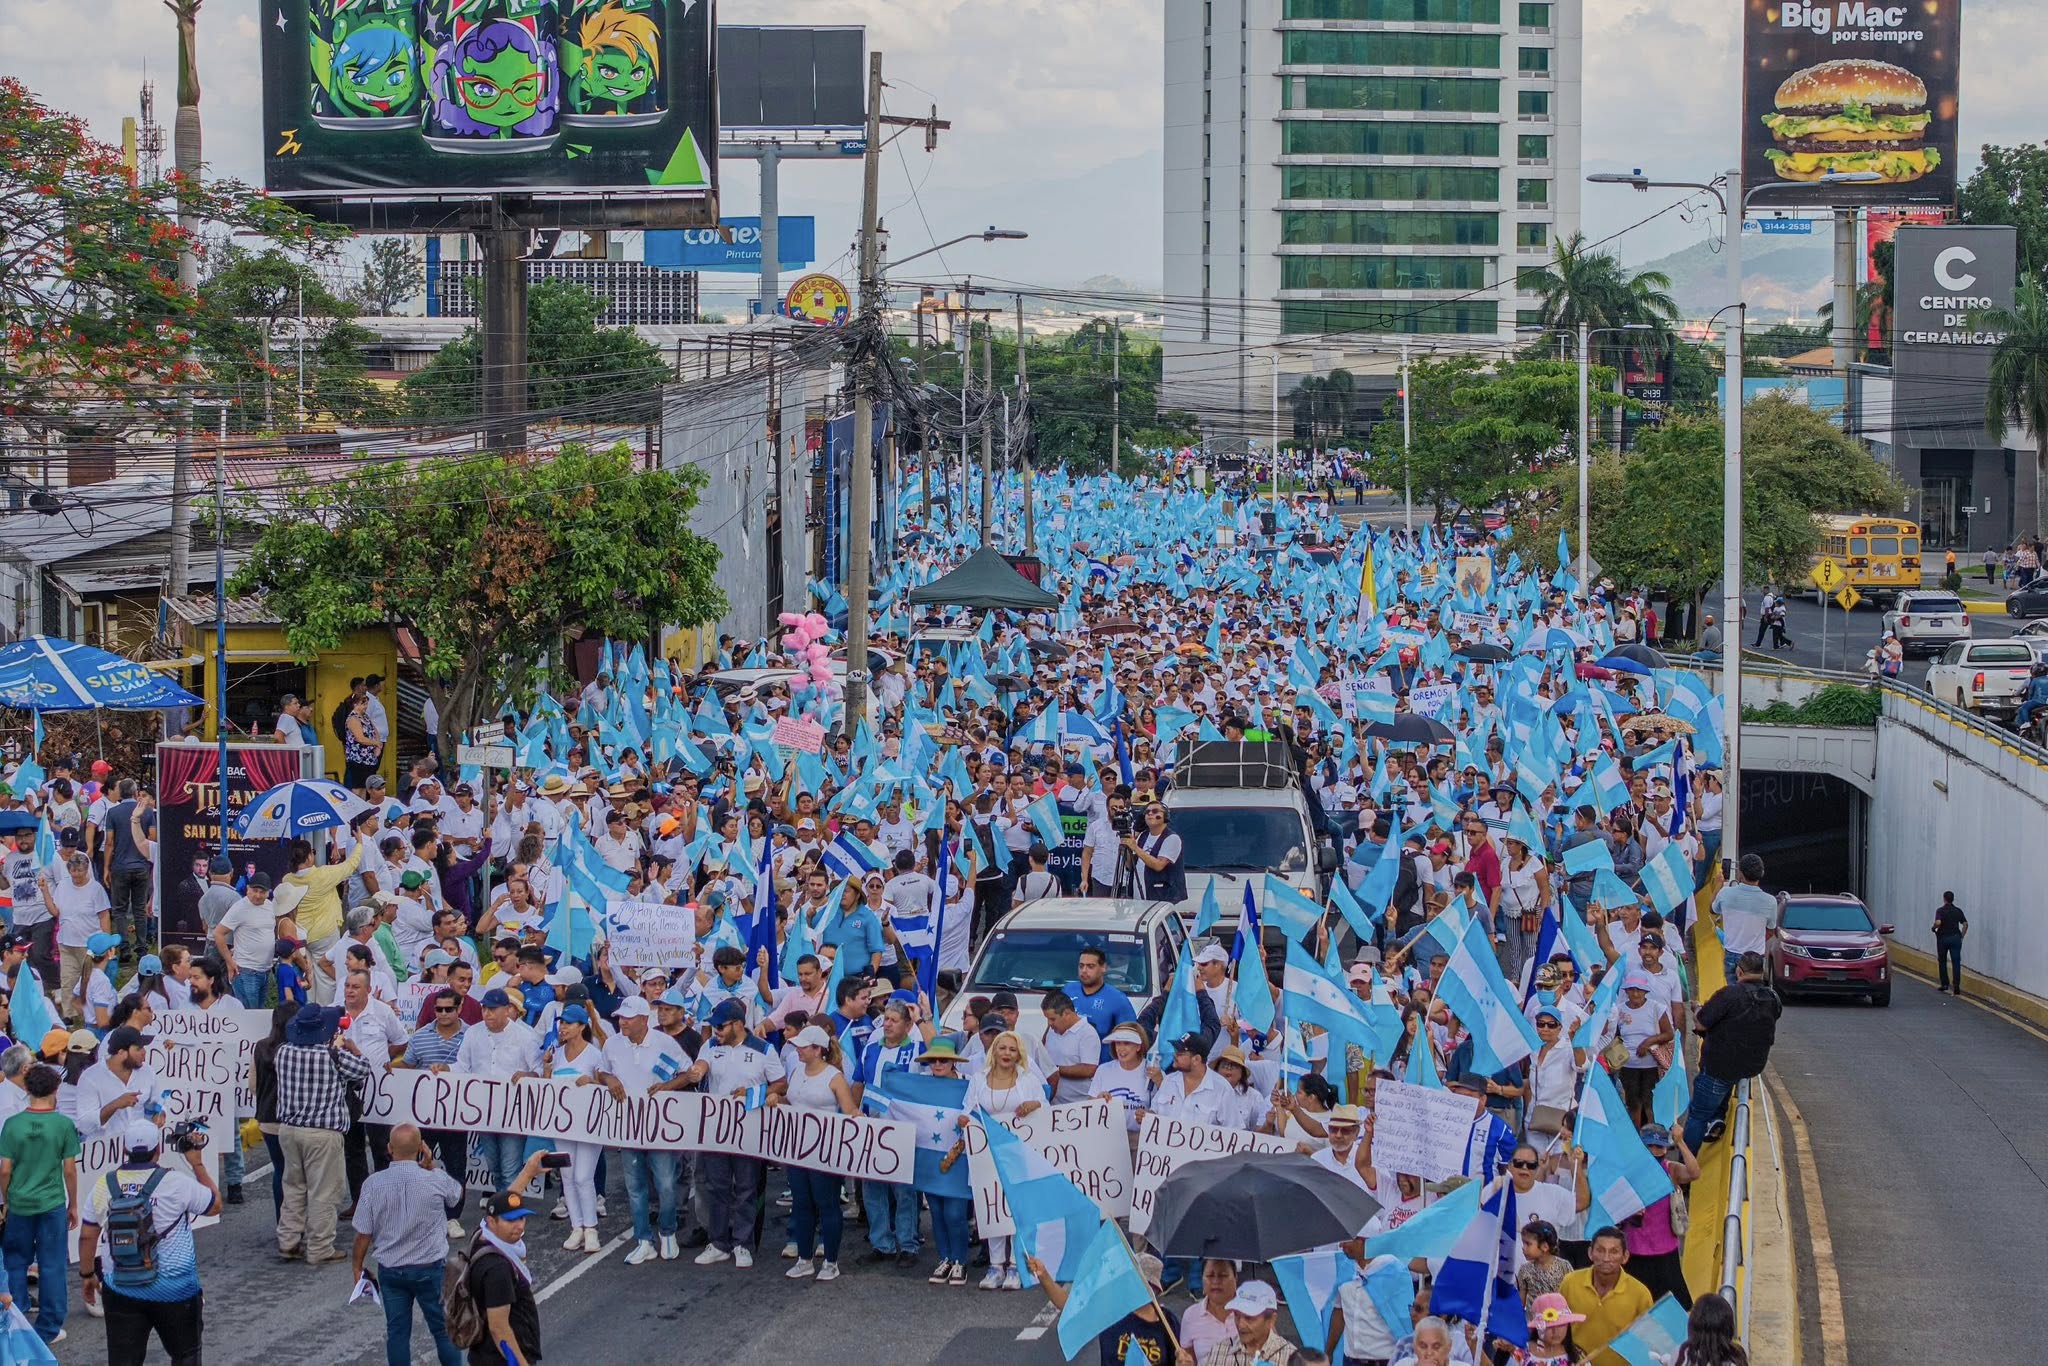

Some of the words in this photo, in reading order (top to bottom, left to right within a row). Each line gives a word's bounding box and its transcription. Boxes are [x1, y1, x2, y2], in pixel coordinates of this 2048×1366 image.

[1781, 0, 1831, 34] Big
[1832, 30, 1859, 44] por
[1861, 28, 1924, 44] siempre
[726, 249, 761, 259] Pintura
[1919, 296, 1993, 310] CENTRO
[1943, 314, 1968, 327] DE
[1903, 331, 2008, 345] CERAMICAS
[1413, 688, 1448, 701] OREMOS
[227, 767, 246, 776] BAC
[184, 825, 207, 839] SAN
[361, 1072, 395, 1118] OS
[411, 1074, 574, 1134] CRISTIANOS
[586, 1087, 685, 1146] ORAMOS
[698, 1095, 745, 1151] POR
[758, 1107, 900, 1175] HONDURAS
[1051, 1104, 1111, 1133] ESTA
[1136, 1150, 1172, 1178] POR
[1132, 1187, 1153, 1217] LA
